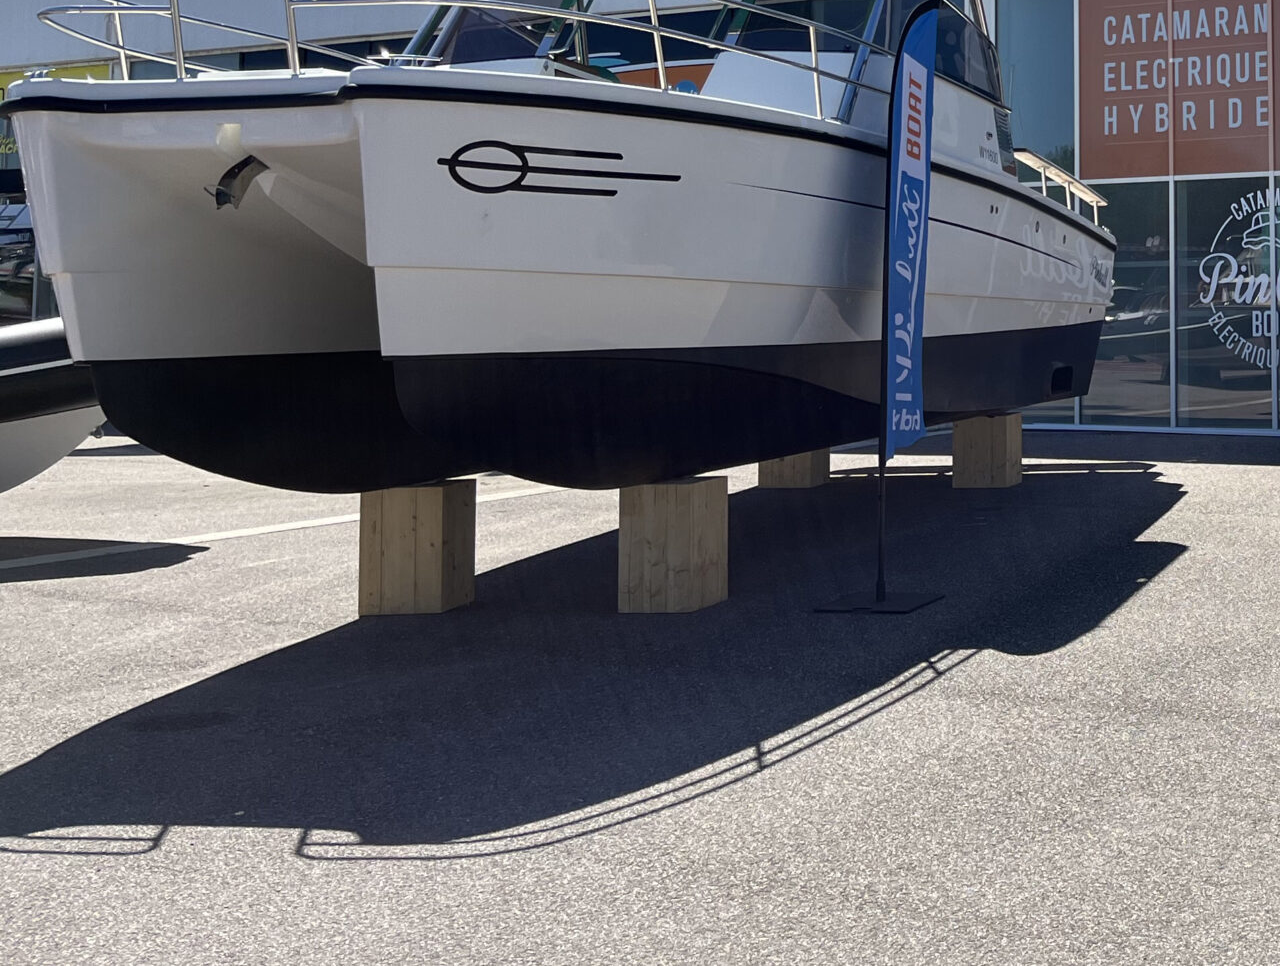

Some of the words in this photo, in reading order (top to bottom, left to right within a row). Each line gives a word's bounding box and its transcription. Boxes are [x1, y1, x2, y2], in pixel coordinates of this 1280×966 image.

[1103, 2, 1269, 47] CATAMARAN
[1103, 51, 1269, 93] ELECTRIQUE
[906, 70, 922, 162] BOAT
[1103, 95, 1270, 136] HYBRIDE
